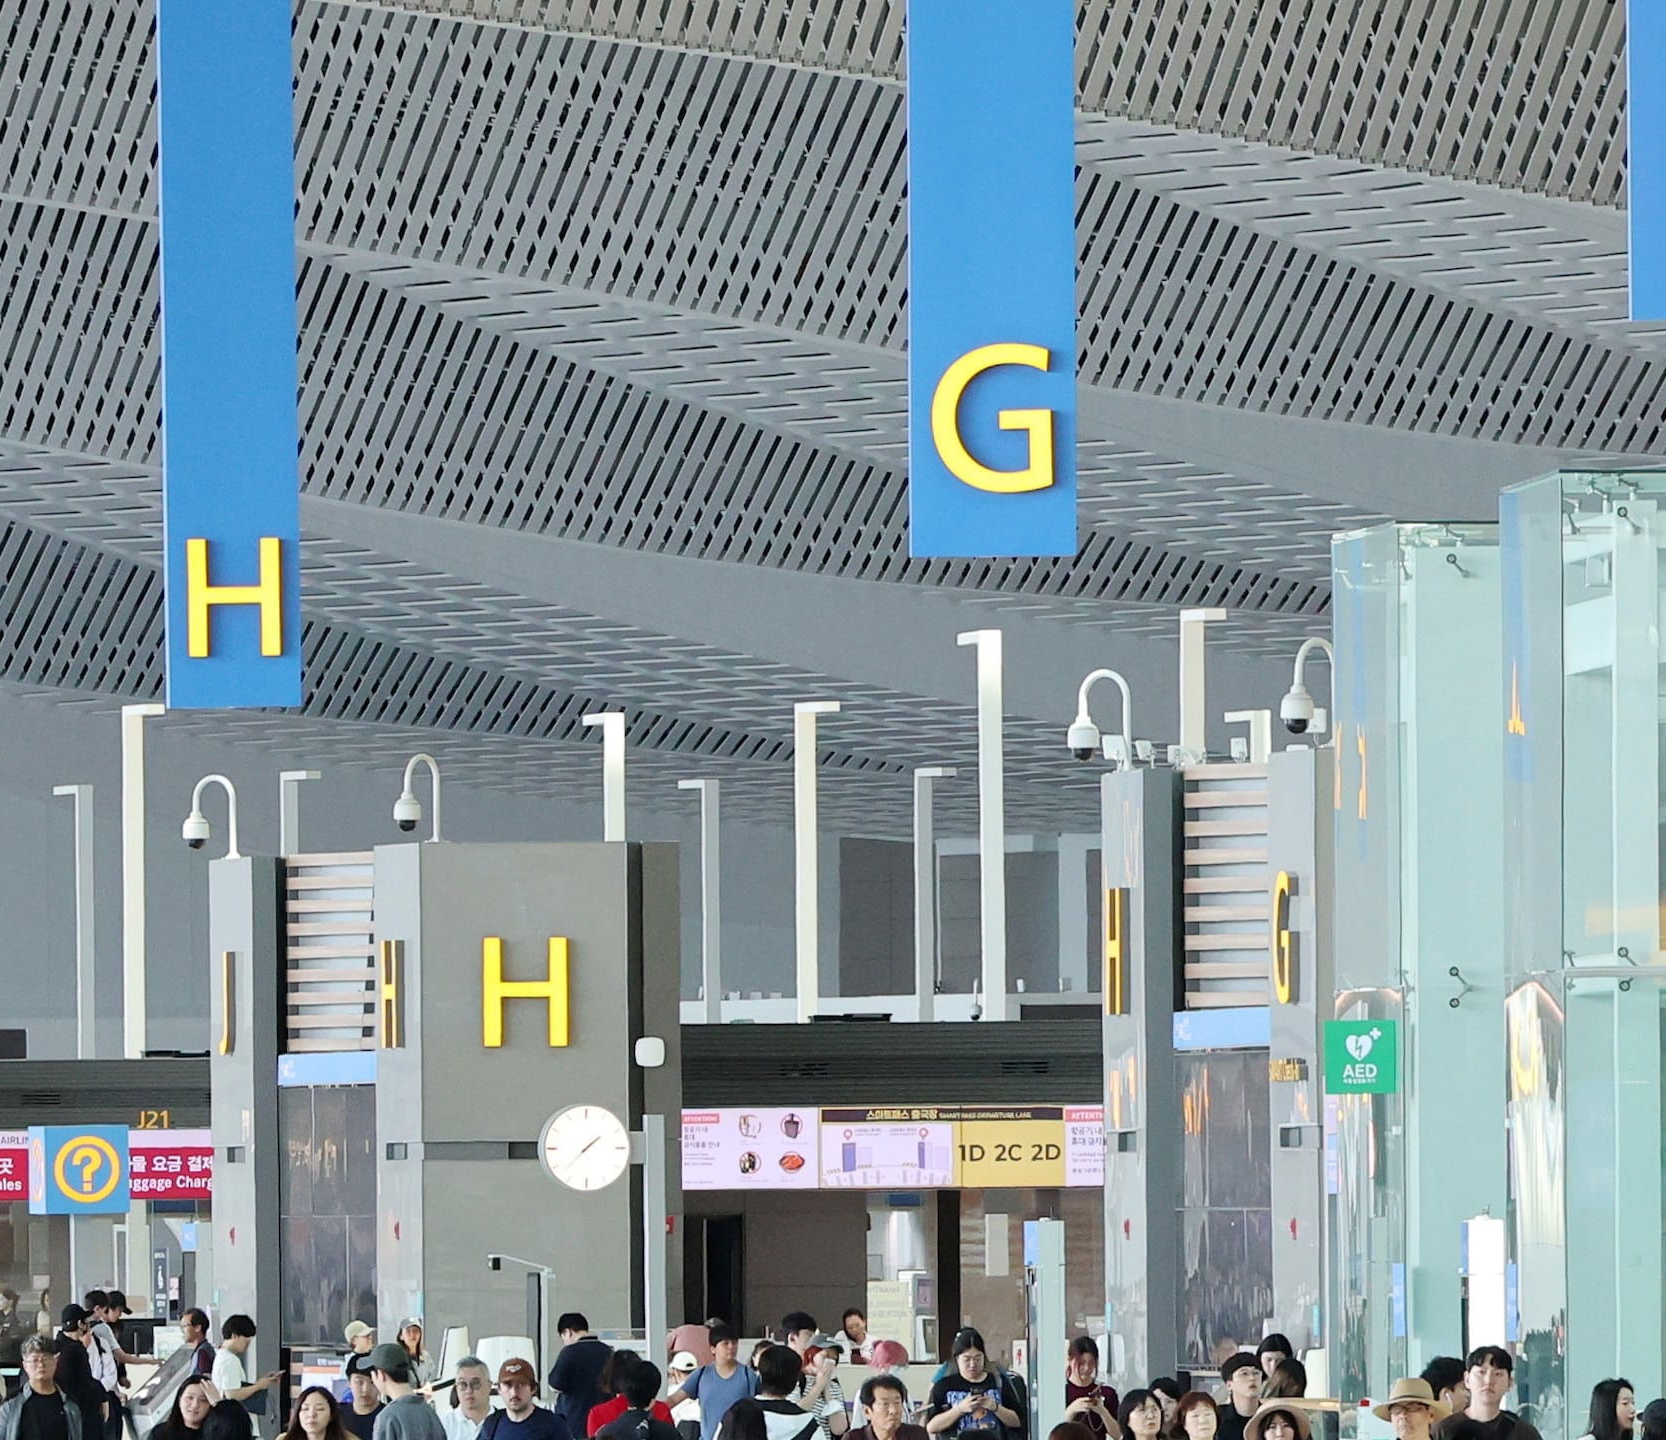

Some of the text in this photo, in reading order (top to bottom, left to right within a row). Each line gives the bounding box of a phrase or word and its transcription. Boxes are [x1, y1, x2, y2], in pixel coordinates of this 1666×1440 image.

[932, 343, 1053, 492] G
[186, 538, 282, 657] H
[1106, 888, 1124, 1016] H
[1273, 871, 1293, 1004] G
[380, 940, 399, 1048] H
[483, 937, 570, 1048] H
[137, 1110, 170, 1129] J21
[1343, 1064, 1378, 1078] AED
[151, 1156, 183, 1172] 요금
[959, 1144, 985, 1161] 1D
[995, 1144, 1022, 1161] 2C
[1031, 1144, 1061, 1161] 2D
